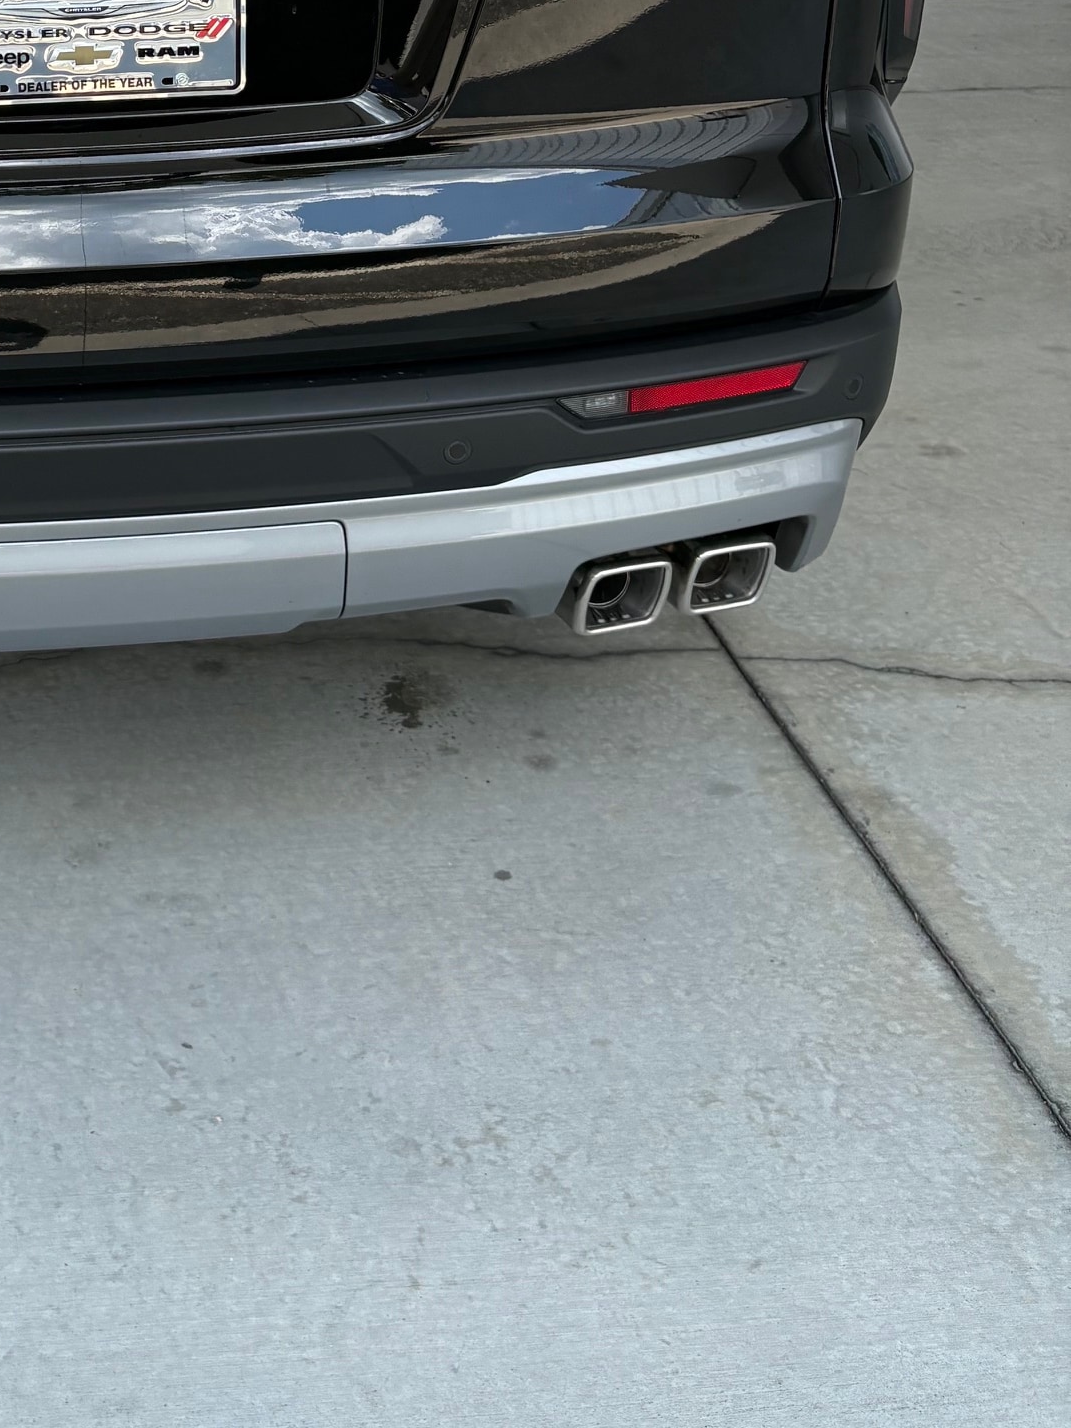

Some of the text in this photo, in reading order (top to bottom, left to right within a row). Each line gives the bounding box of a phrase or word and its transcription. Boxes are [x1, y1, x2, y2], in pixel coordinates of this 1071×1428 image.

[88, 22, 209, 36] DODGE
[137, 45, 200, 58] RAM
[18, 77, 153, 93] DEALER OF THE YEAR
